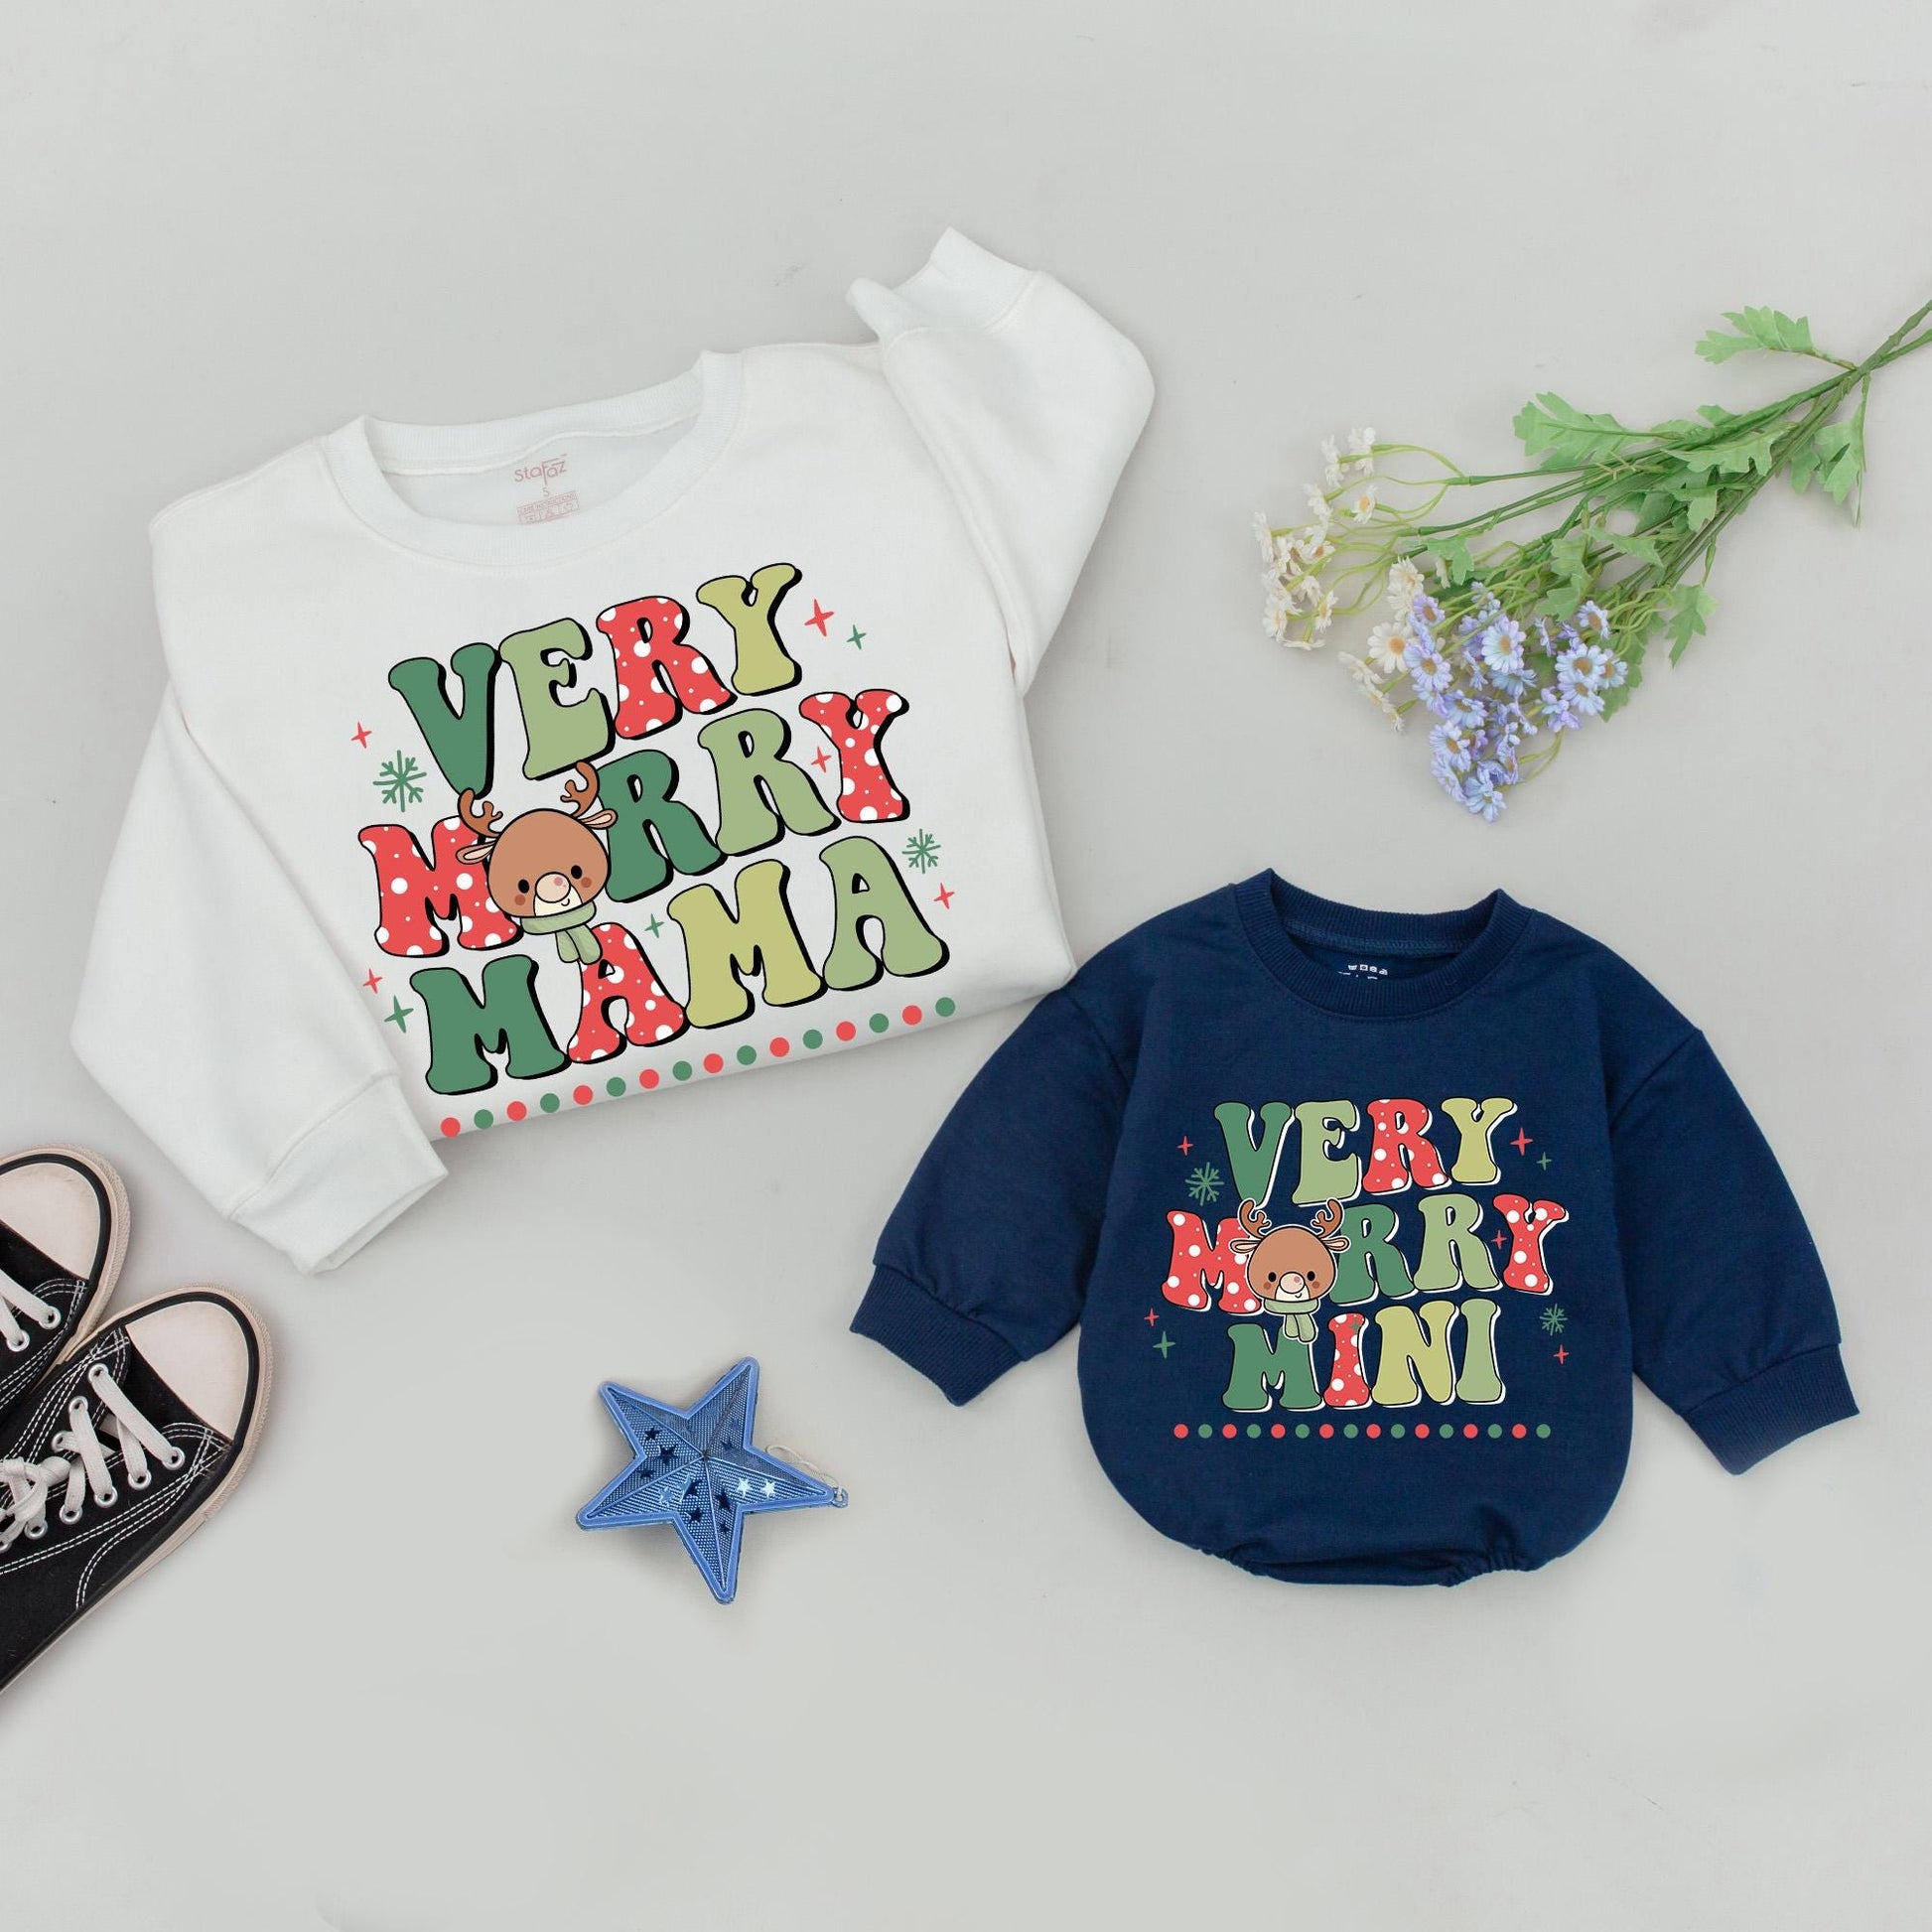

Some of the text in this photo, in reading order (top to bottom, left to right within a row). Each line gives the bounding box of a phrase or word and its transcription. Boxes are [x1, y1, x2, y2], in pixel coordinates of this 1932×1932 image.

[388, 563, 802, 795] VERY
[358, 689, 909, 957] MRRY
[409, 836, 950, 1094] MAMA
[1213, 1097, 1518, 1207] VERY
[1161, 1193, 1569, 1315] MRRY
[1222, 1298, 1506, 1412] MINI
